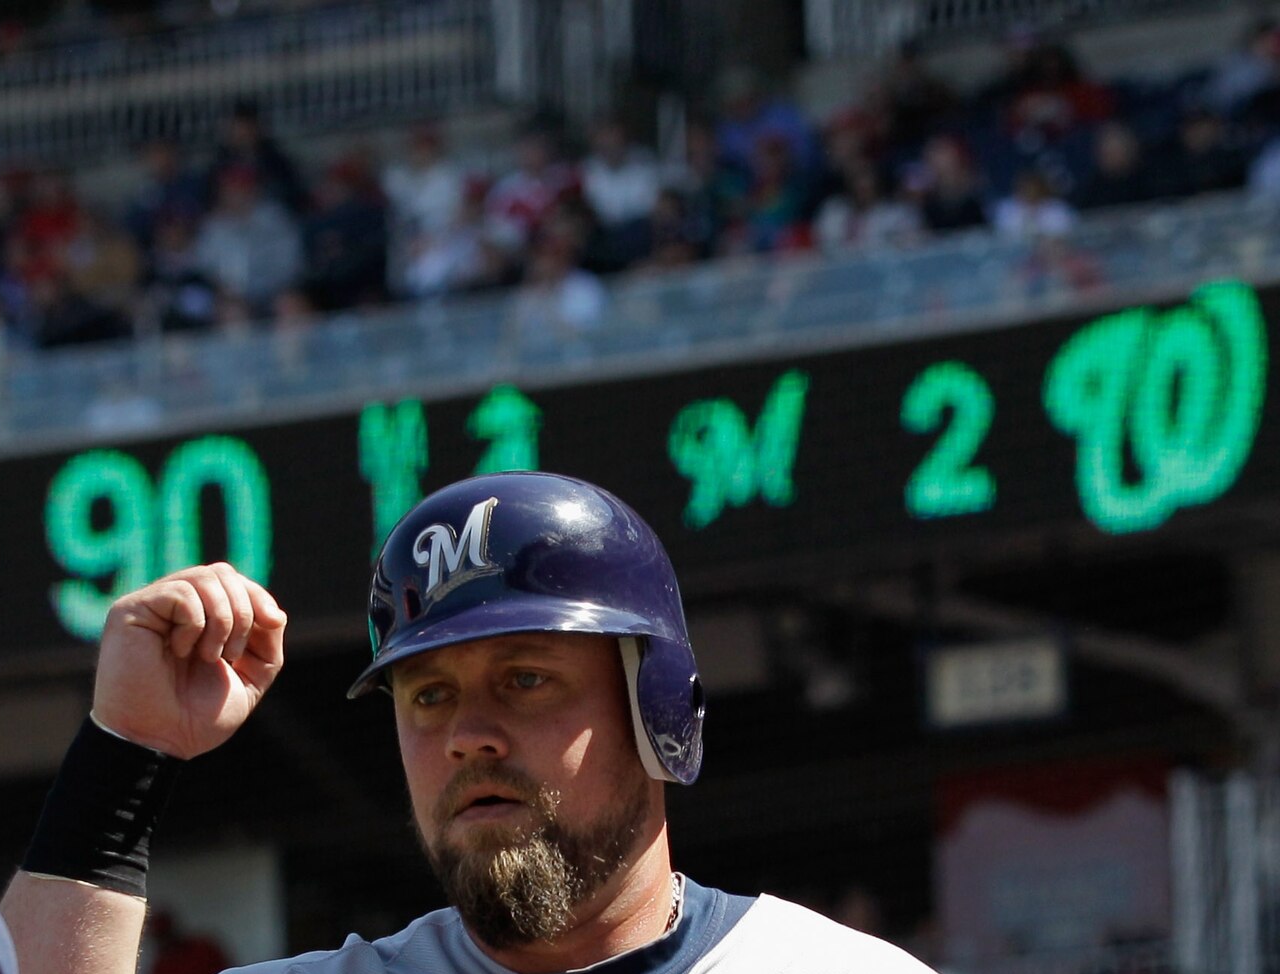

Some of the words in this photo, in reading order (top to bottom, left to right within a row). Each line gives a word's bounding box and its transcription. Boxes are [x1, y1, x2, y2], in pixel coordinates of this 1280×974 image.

[900, 360, 996, 519] 2
[44, 434, 273, 643] 90
[412, 496, 499, 600] M
